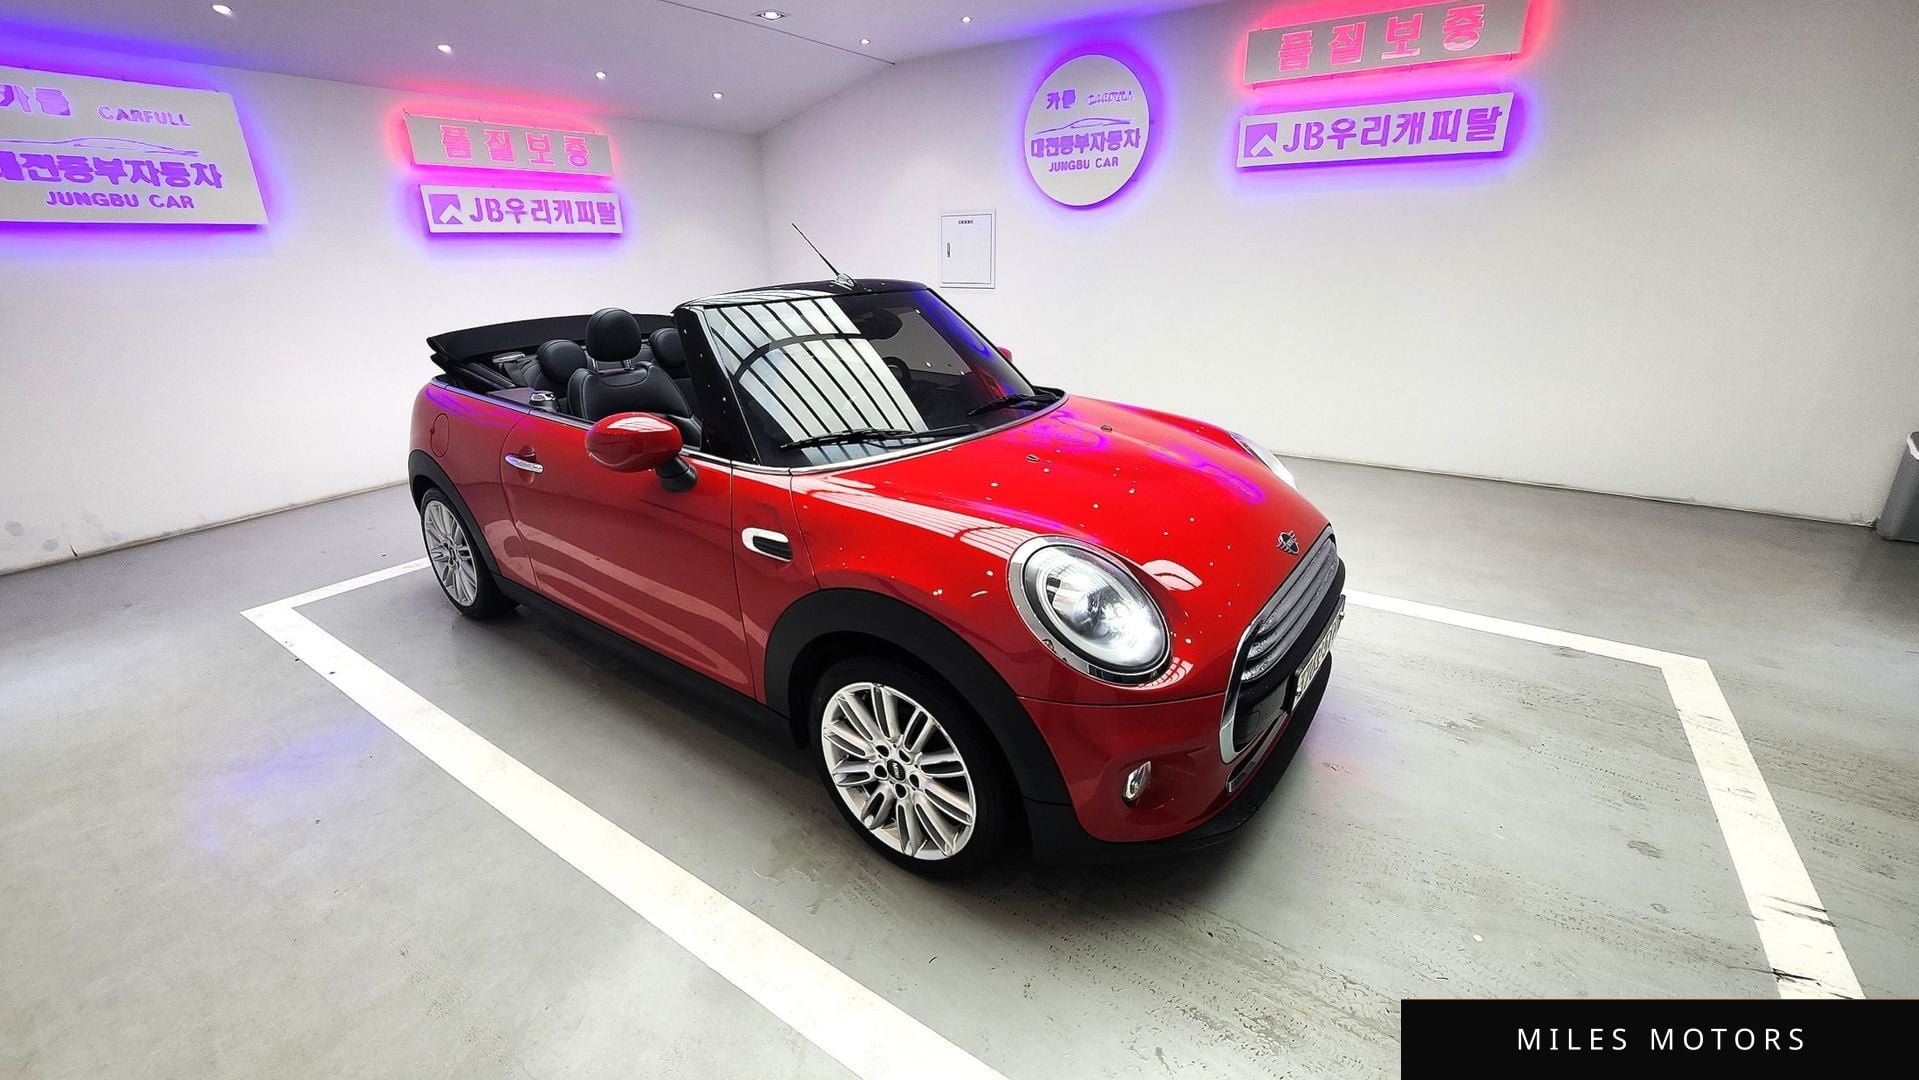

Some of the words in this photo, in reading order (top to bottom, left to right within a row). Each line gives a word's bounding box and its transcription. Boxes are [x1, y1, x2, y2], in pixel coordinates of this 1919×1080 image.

[97, 105, 190, 127] CARFULL
[1283, 106, 1502, 152] JB우리캐피탈
[1031, 127, 1141, 158] 대전중부자동차
[1048, 159, 1090, 173] JUNGBU
[1095, 156, 1119, 169] CAR
[46, 191, 139, 208] JUNGBU
[149, 194, 195, 209] CAR
[469, 197, 616, 226] JB우리캐피탈
